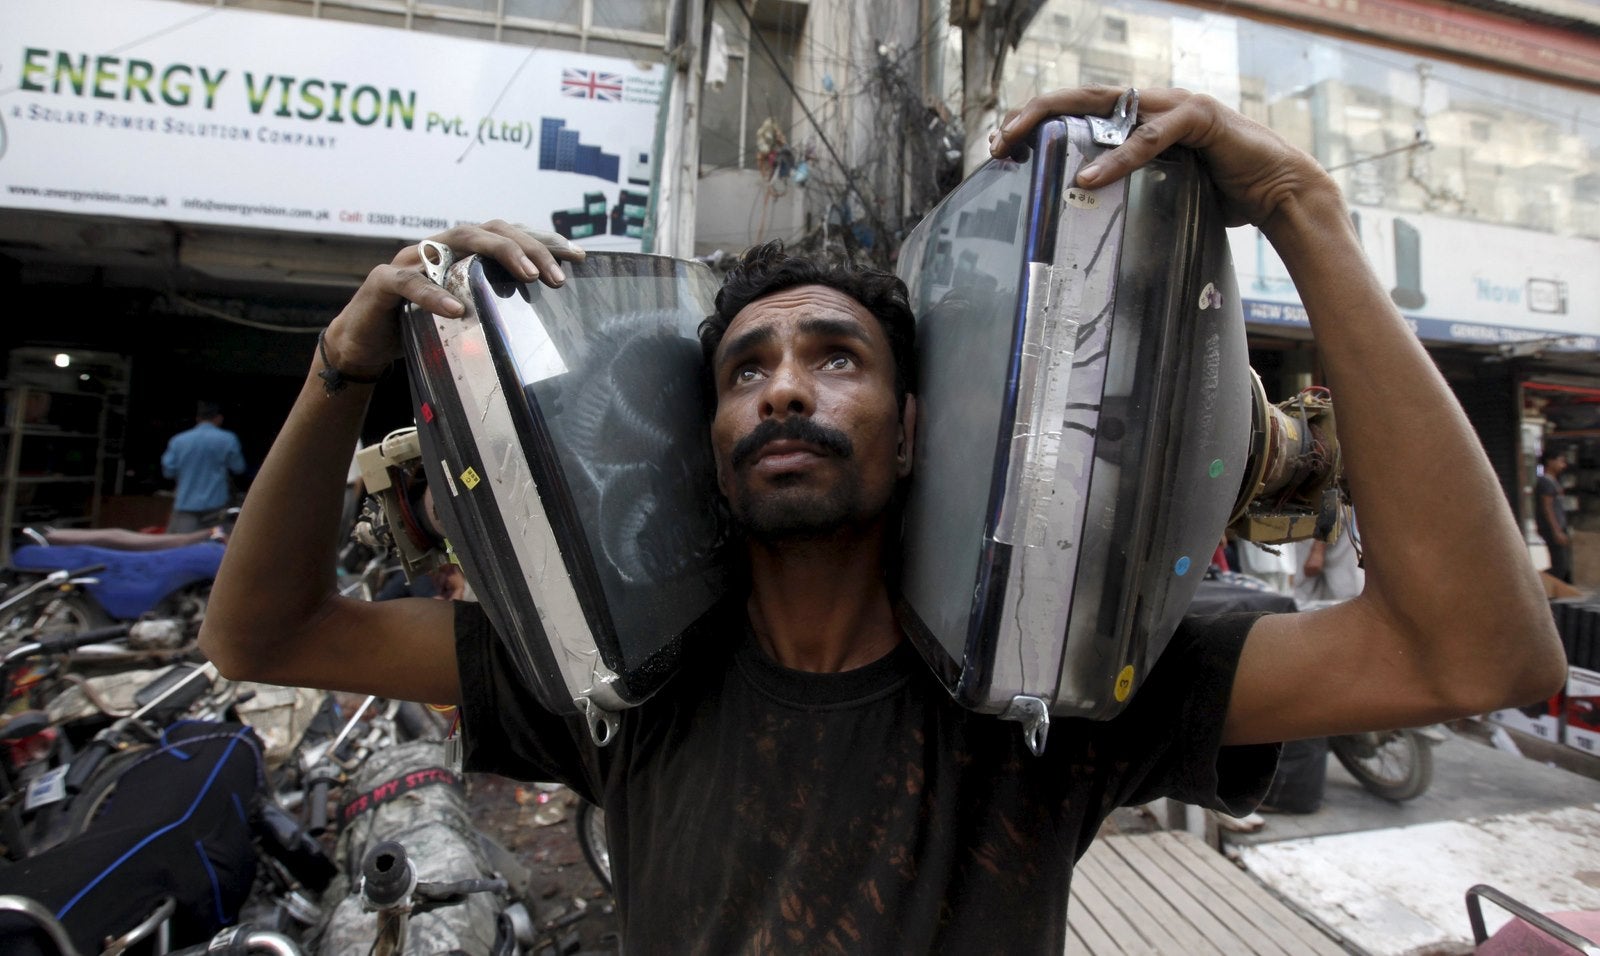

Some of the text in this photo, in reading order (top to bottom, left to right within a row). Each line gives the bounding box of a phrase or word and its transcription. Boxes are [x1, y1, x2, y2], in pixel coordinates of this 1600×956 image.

[20, 47, 534, 150] ENERGY VISION Pvt. (Ltd)
